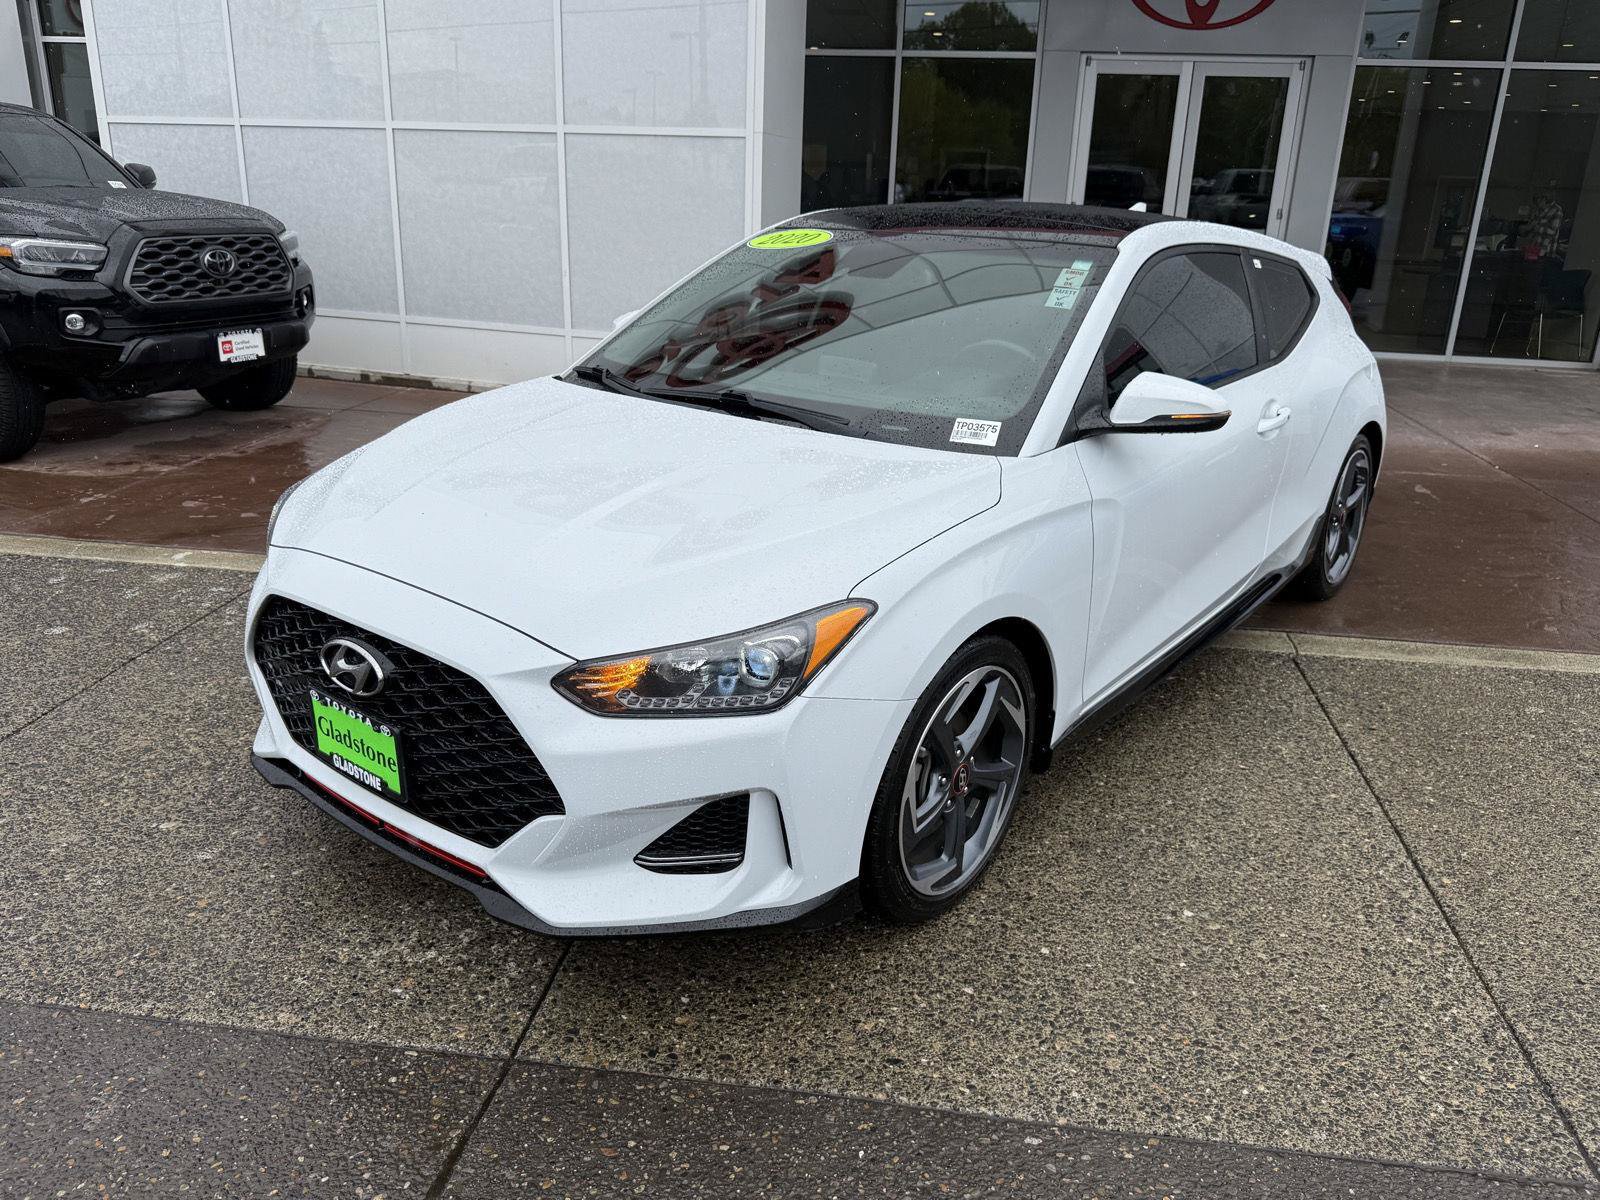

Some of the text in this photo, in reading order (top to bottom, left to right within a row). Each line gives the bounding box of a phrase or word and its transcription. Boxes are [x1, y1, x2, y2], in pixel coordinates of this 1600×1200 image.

[757, 234, 822, 244] 2020
[1053, 288, 1077, 296] SAFETY
[956, 421, 998, 433] TP03575
[326, 697, 372, 727] TOYOTA
[318, 716, 396, 772] Gladstone
[332, 754, 382, 791] GLADSTONE
